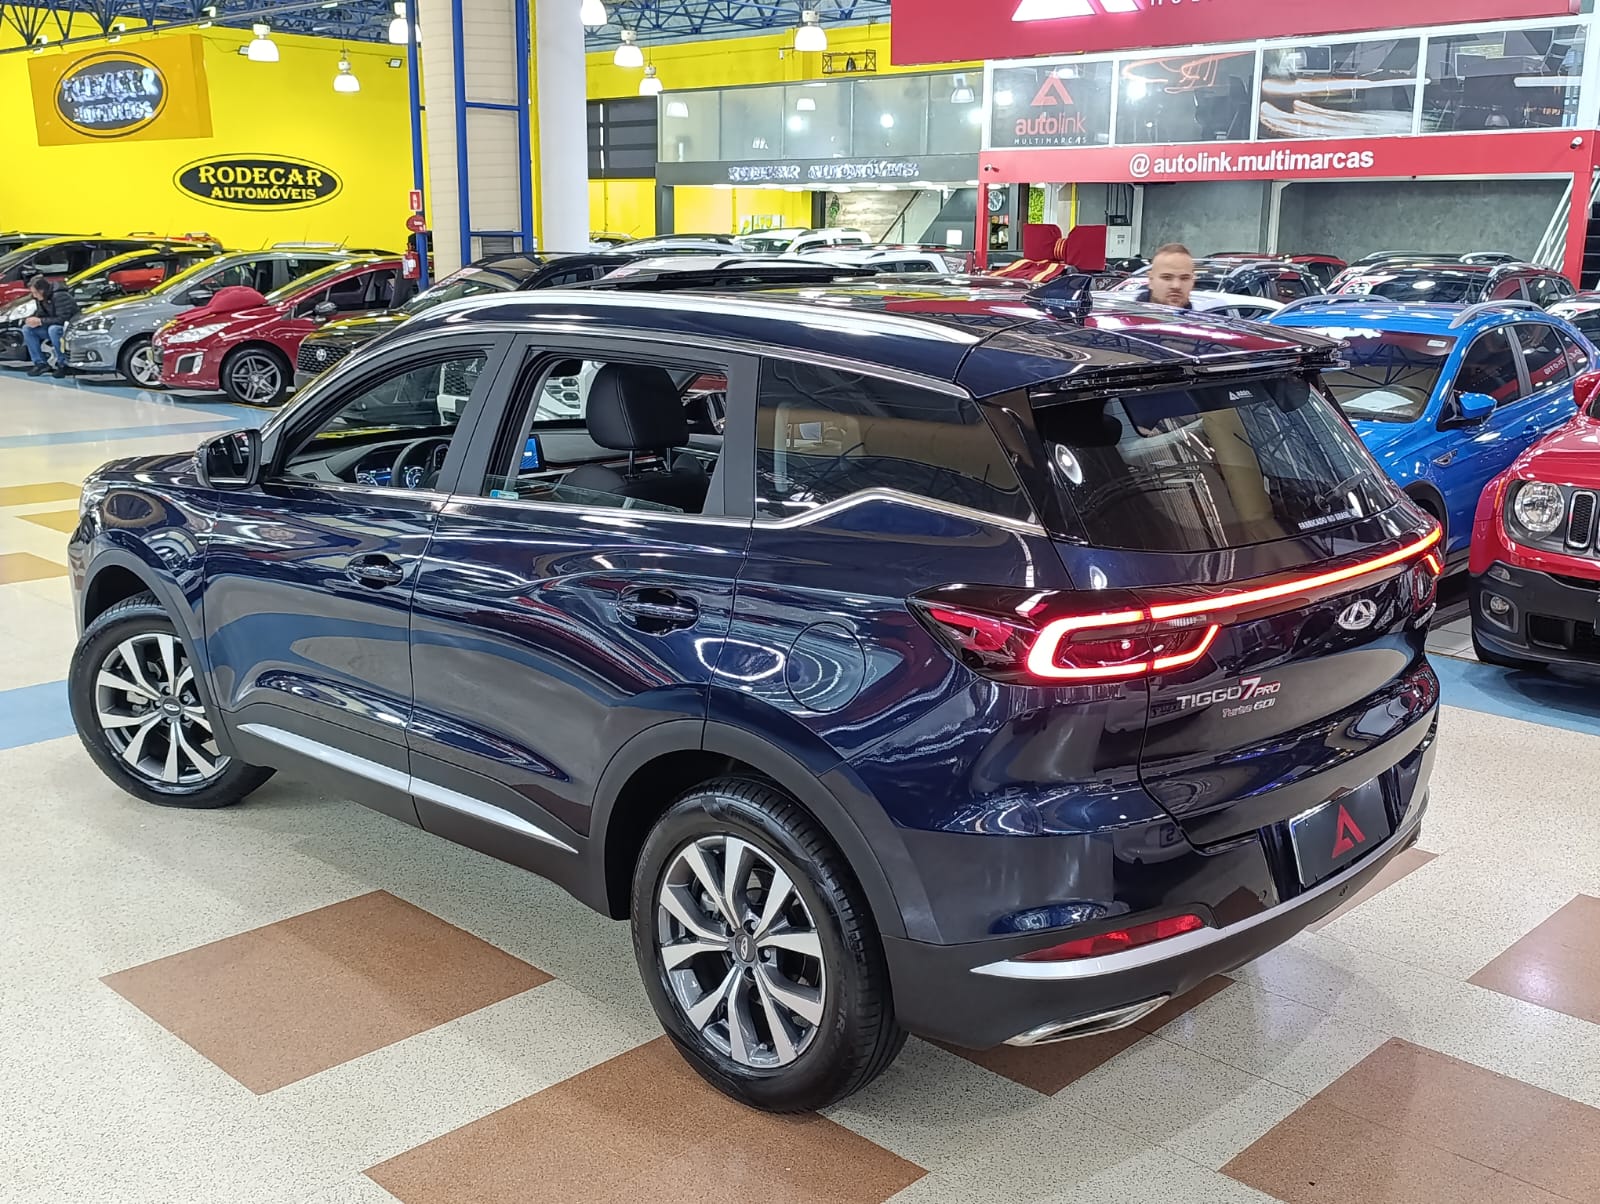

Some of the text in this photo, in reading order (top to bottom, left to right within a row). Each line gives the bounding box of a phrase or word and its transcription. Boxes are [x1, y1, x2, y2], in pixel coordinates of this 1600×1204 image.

[1015, 111, 1087, 136] autolink
[198, 165, 323, 187] RODECAR
[210, 184, 317, 200] AUTOMÓVEIS
